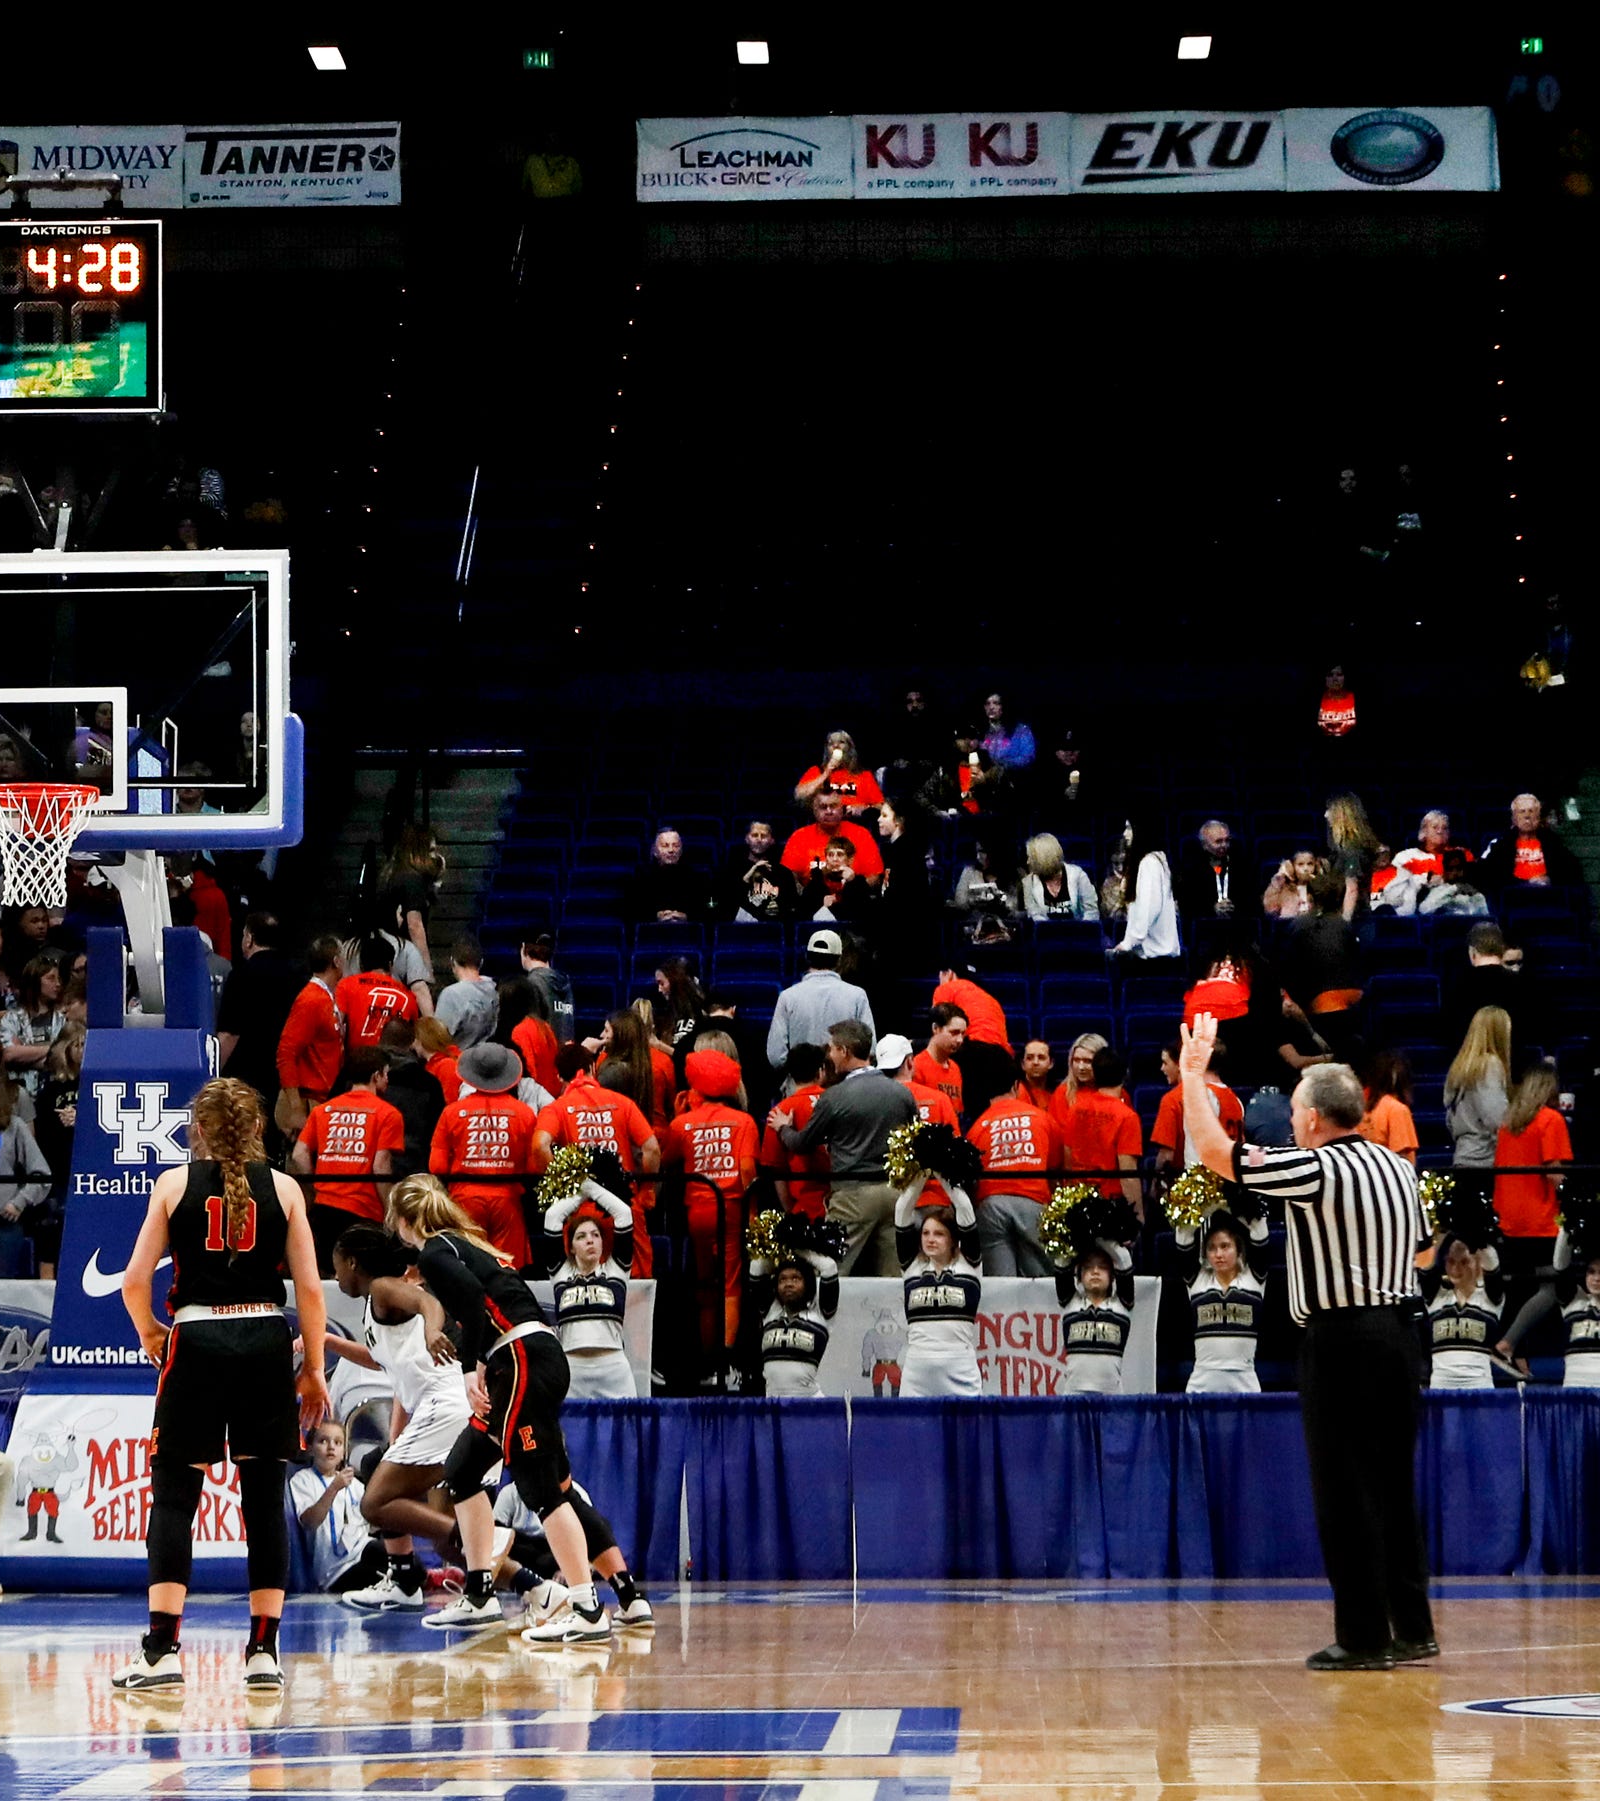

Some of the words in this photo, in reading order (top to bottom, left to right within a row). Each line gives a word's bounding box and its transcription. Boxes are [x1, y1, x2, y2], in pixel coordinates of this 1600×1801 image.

[186, 128, 368, 176] TANNER
[865, 123, 936, 169] KU
[968, 122, 1038, 168] KU
[1086, 121, 1271, 169] EKU
[32, 145, 178, 170] MIDWAY
[680, 147, 813, 168] LEACHMAN
[219, 178, 288, 190] STANTON,
[290, 176, 364, 188] KENTUCKY
[641, 172, 710, 187] BUICK
[720, 172, 771, 186] GMC
[877, 179, 900, 188] PPL
[904, 179, 955, 191] company
[980, 178, 1003, 188] PPL
[1006, 177, 1057, 189] company
[21, 226, 111, 235] DAKTRONICS
[28, 243, 140, 292] 4:28
[93, 1082, 191, 1164] UK
[328, 1112, 367, 1125] 2018
[467, 1116, 509, 1130] 2018
[576, 1111, 612, 1125] 2018
[990, 1116, 1031, 1134] 2018
[327, 1126, 365, 1139] 2019
[467, 1131, 509, 1144] 2019
[578, 1126, 615, 1140] 2019
[692, 1127, 731, 1143] 2018
[991, 1129, 1032, 1146] 2019
[694, 1142, 732, 1158] 2019
[205, 1196, 257, 1252] 10
[51, 1346, 150, 1365] UKathlet
[518, 1425, 537, 1452] E
